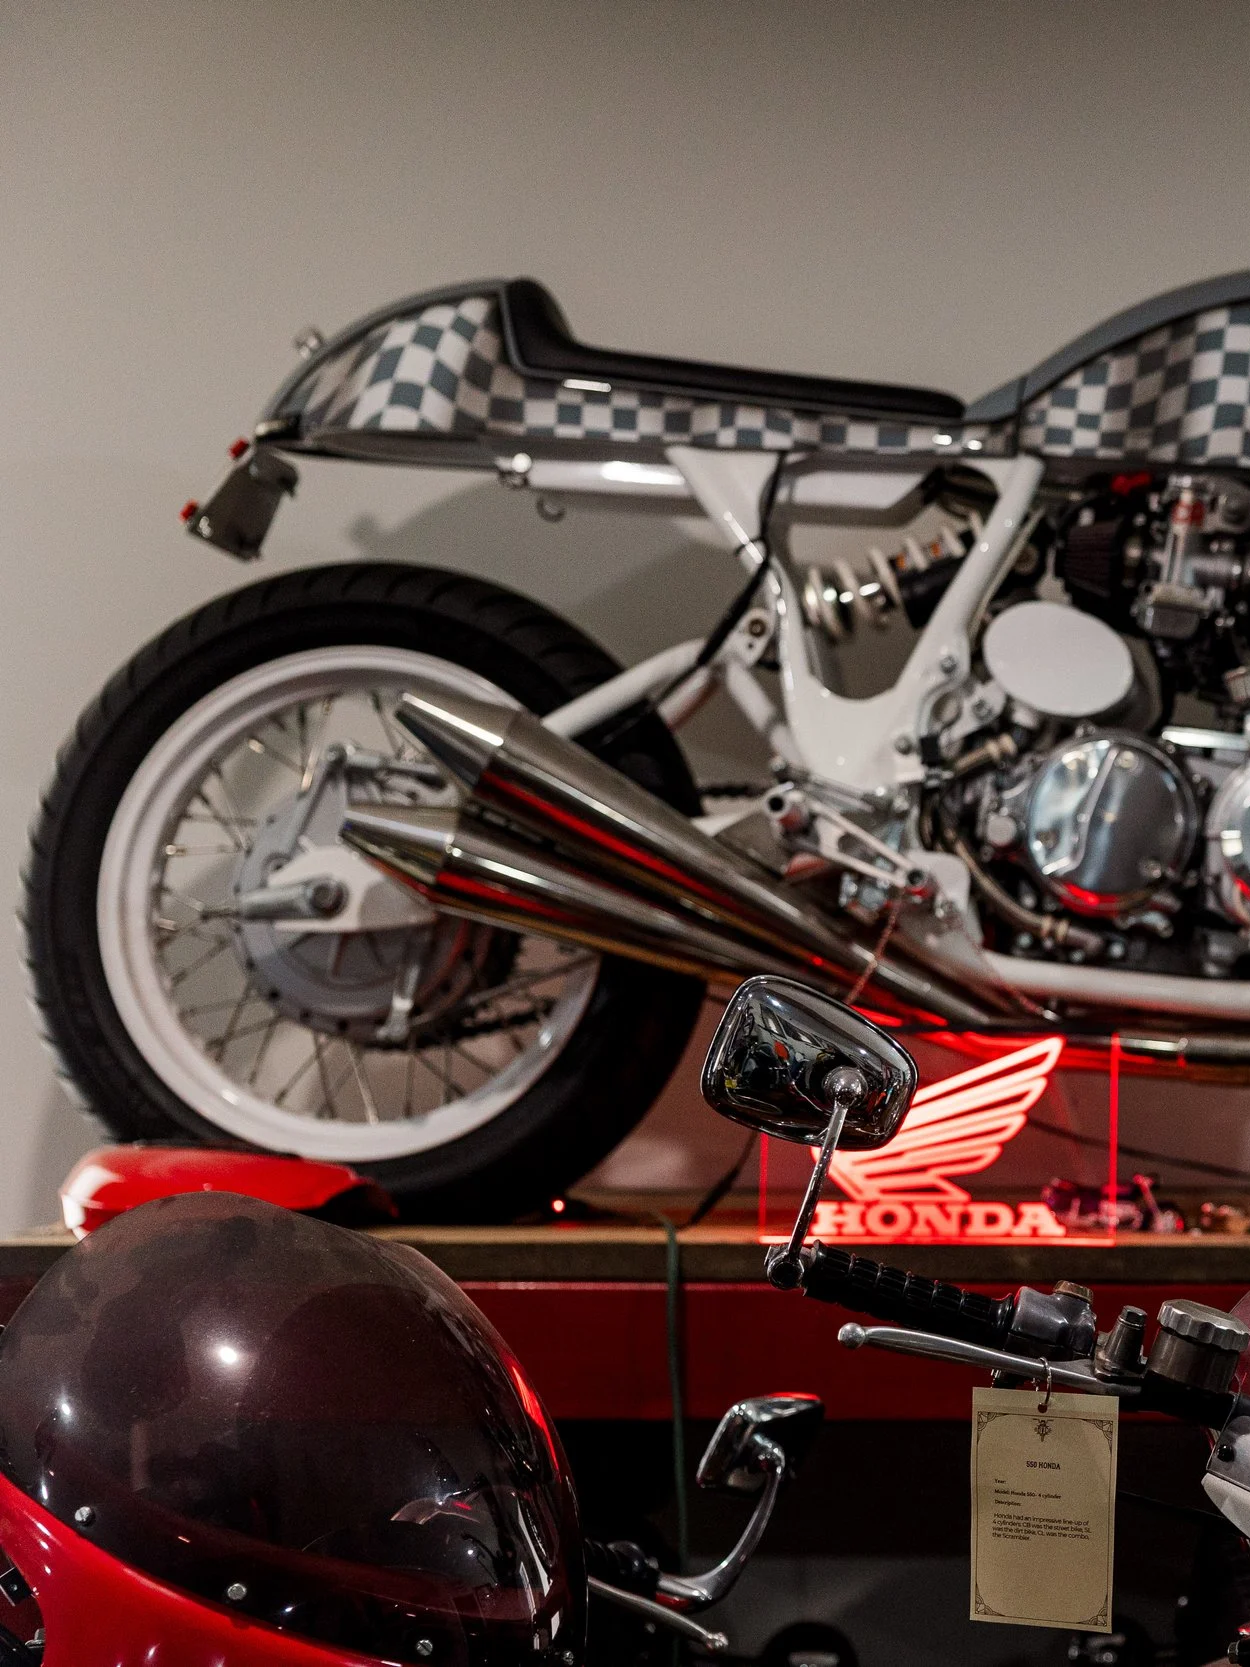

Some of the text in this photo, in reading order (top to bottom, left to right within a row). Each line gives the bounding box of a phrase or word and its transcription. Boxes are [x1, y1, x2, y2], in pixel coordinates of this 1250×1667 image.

[810, 1200, 1067, 1237] HONDA
[1032, 1516, 1062, 1524] impressive
[1063, 1518, 1082, 1526] line-up
